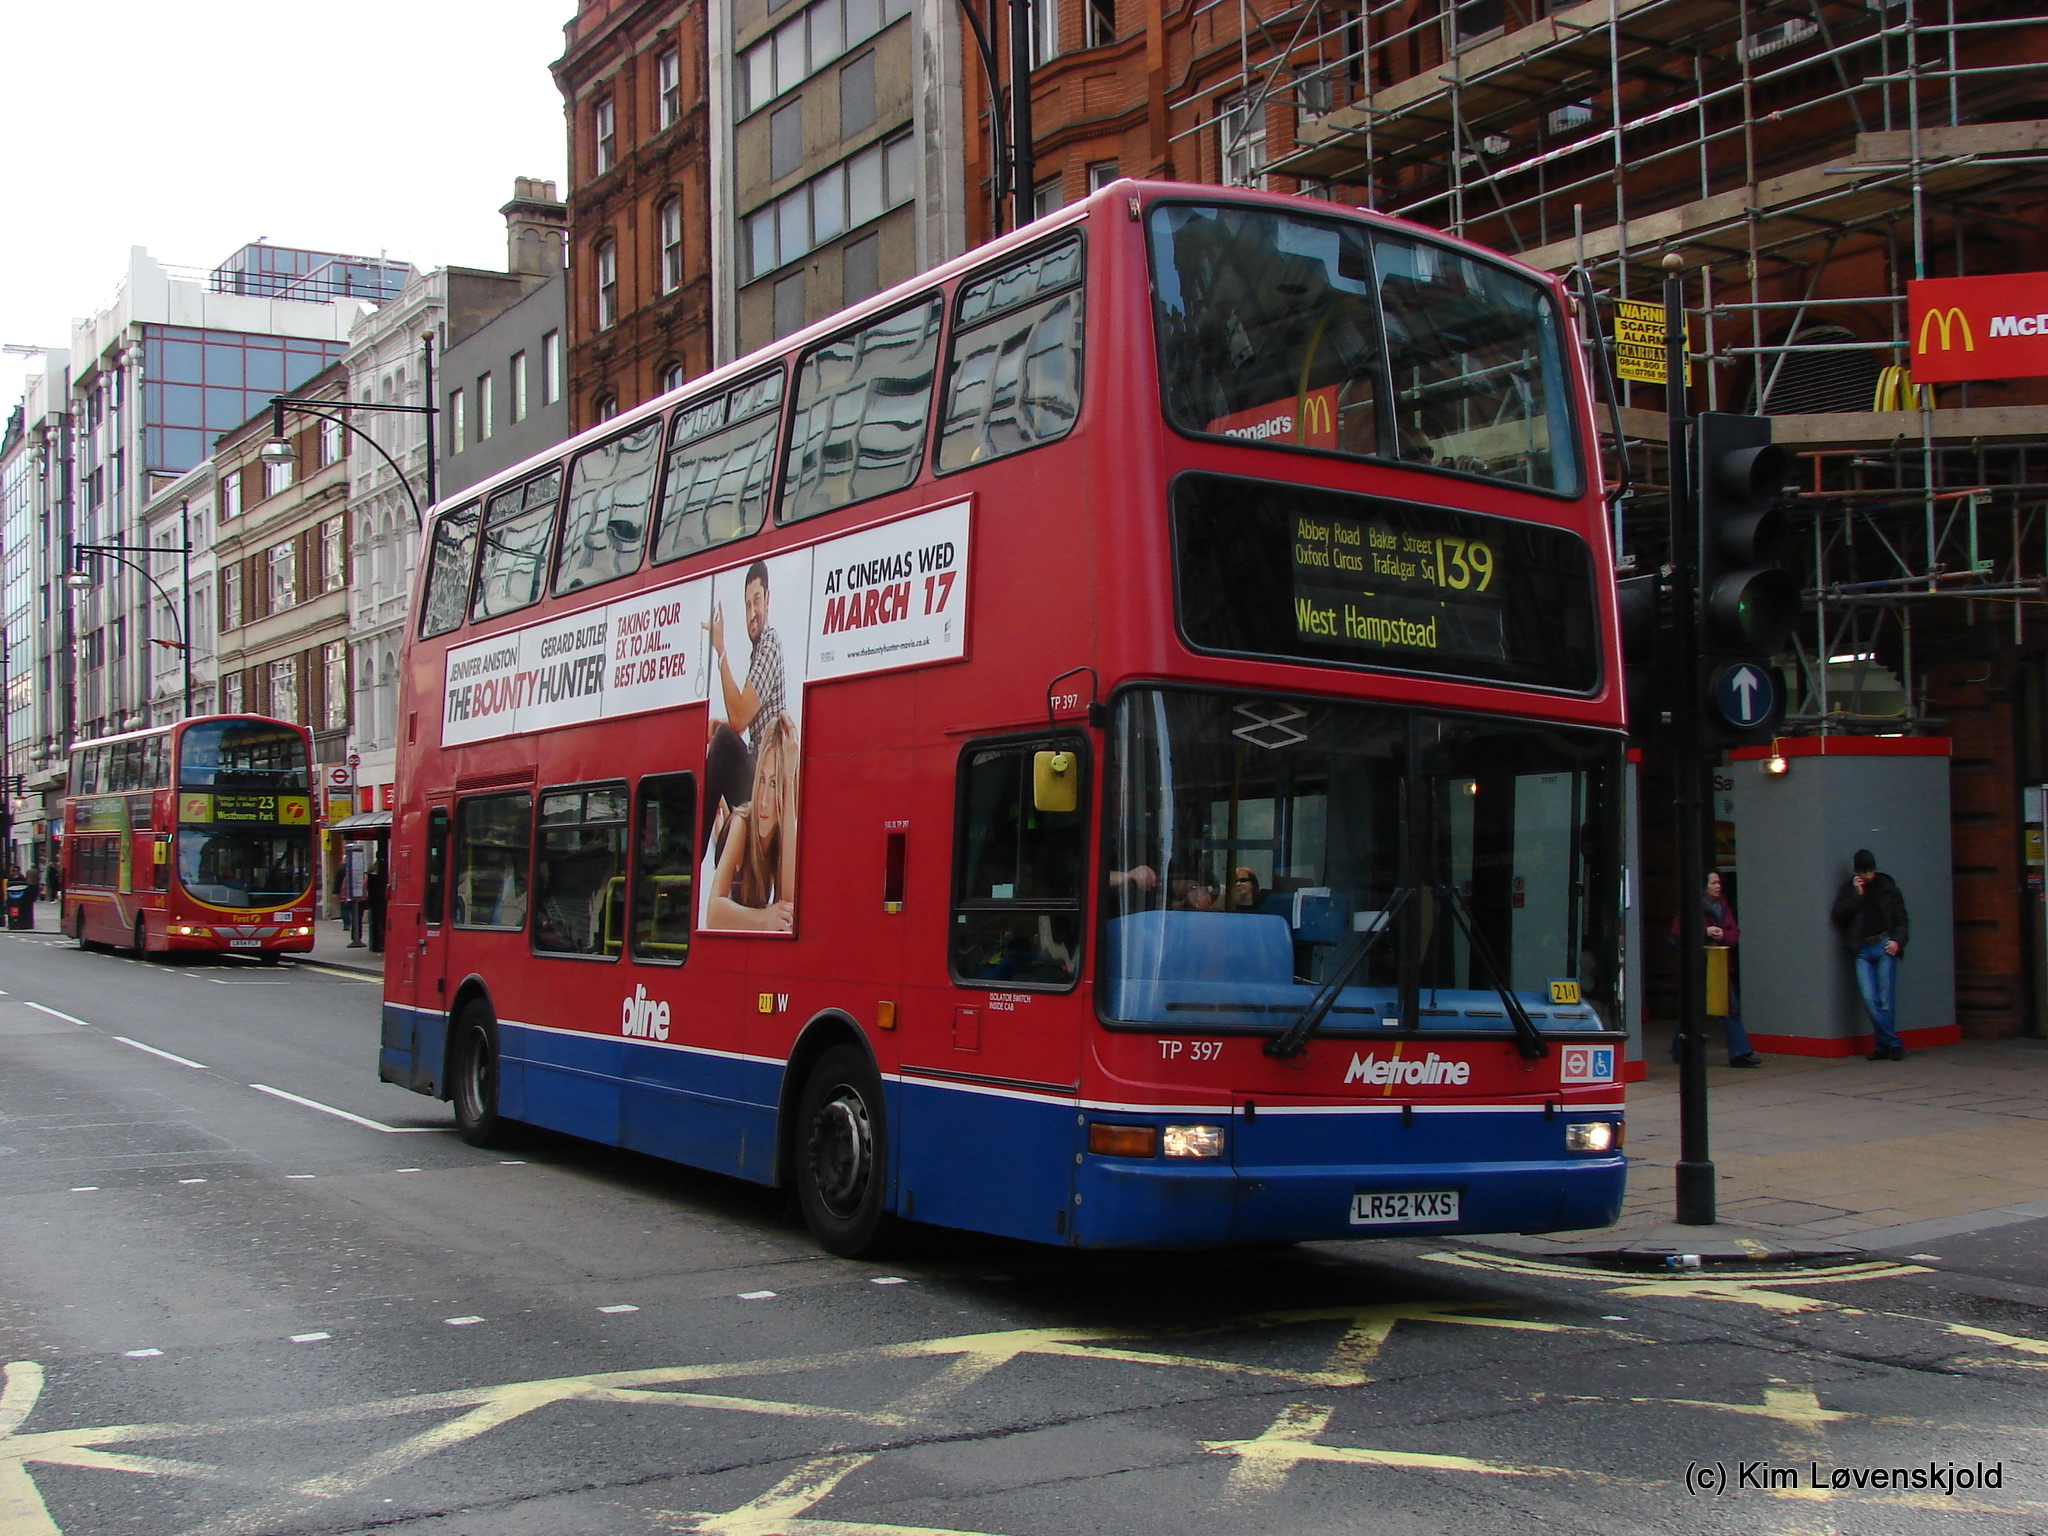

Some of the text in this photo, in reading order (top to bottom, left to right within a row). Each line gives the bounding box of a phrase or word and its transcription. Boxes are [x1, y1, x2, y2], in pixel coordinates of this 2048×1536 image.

[1619, 303, 1665, 322] WARNI
[1620, 321, 1666, 334] SCAFFO
[1624, 332, 1664, 345] ALARM
[1297, 518, 1432, 555] Abbey Road Baker Street
[825, 541, 955, 595] AT CINEMAS WED
[1295, 544, 1435, 585] Oxford Circus Trafalgar Sq
[1435, 538, 1493, 592] 139
[822, 570, 957, 635] MARCH 17
[617, 602, 681, 637] TAKING YOUR
[1295, 597, 1436, 648] West Hampstead
[541, 621, 608, 659] GERARD BUTLER
[615, 630, 671, 660] EX TO JAIL...
[450, 646, 518, 682] JENNIFER ANISTON
[614, 652, 686, 689] BEST JOB EVER.
[448, 653, 607, 723] THE BOUNTY HUNTER
[1050, 694, 1078, 710] TP 397
[217, 810, 275, 821] Westbourne Park
[258, 796, 275, 809] 23
[233, 914, 249, 923] First
[622, 983, 671, 1041] oline
[760, 993, 789, 1012] 211 W
[989, 992, 1031, 1003] ISOLATOR SWITCH
[989, 1002, 1014, 1011] INSIDE CAB
[1158, 1040, 1223, 1061] TP 397
[1343, 1050, 1470, 1086] Metroline
[1357, 1193, 1452, 1218] LR52 KXS
